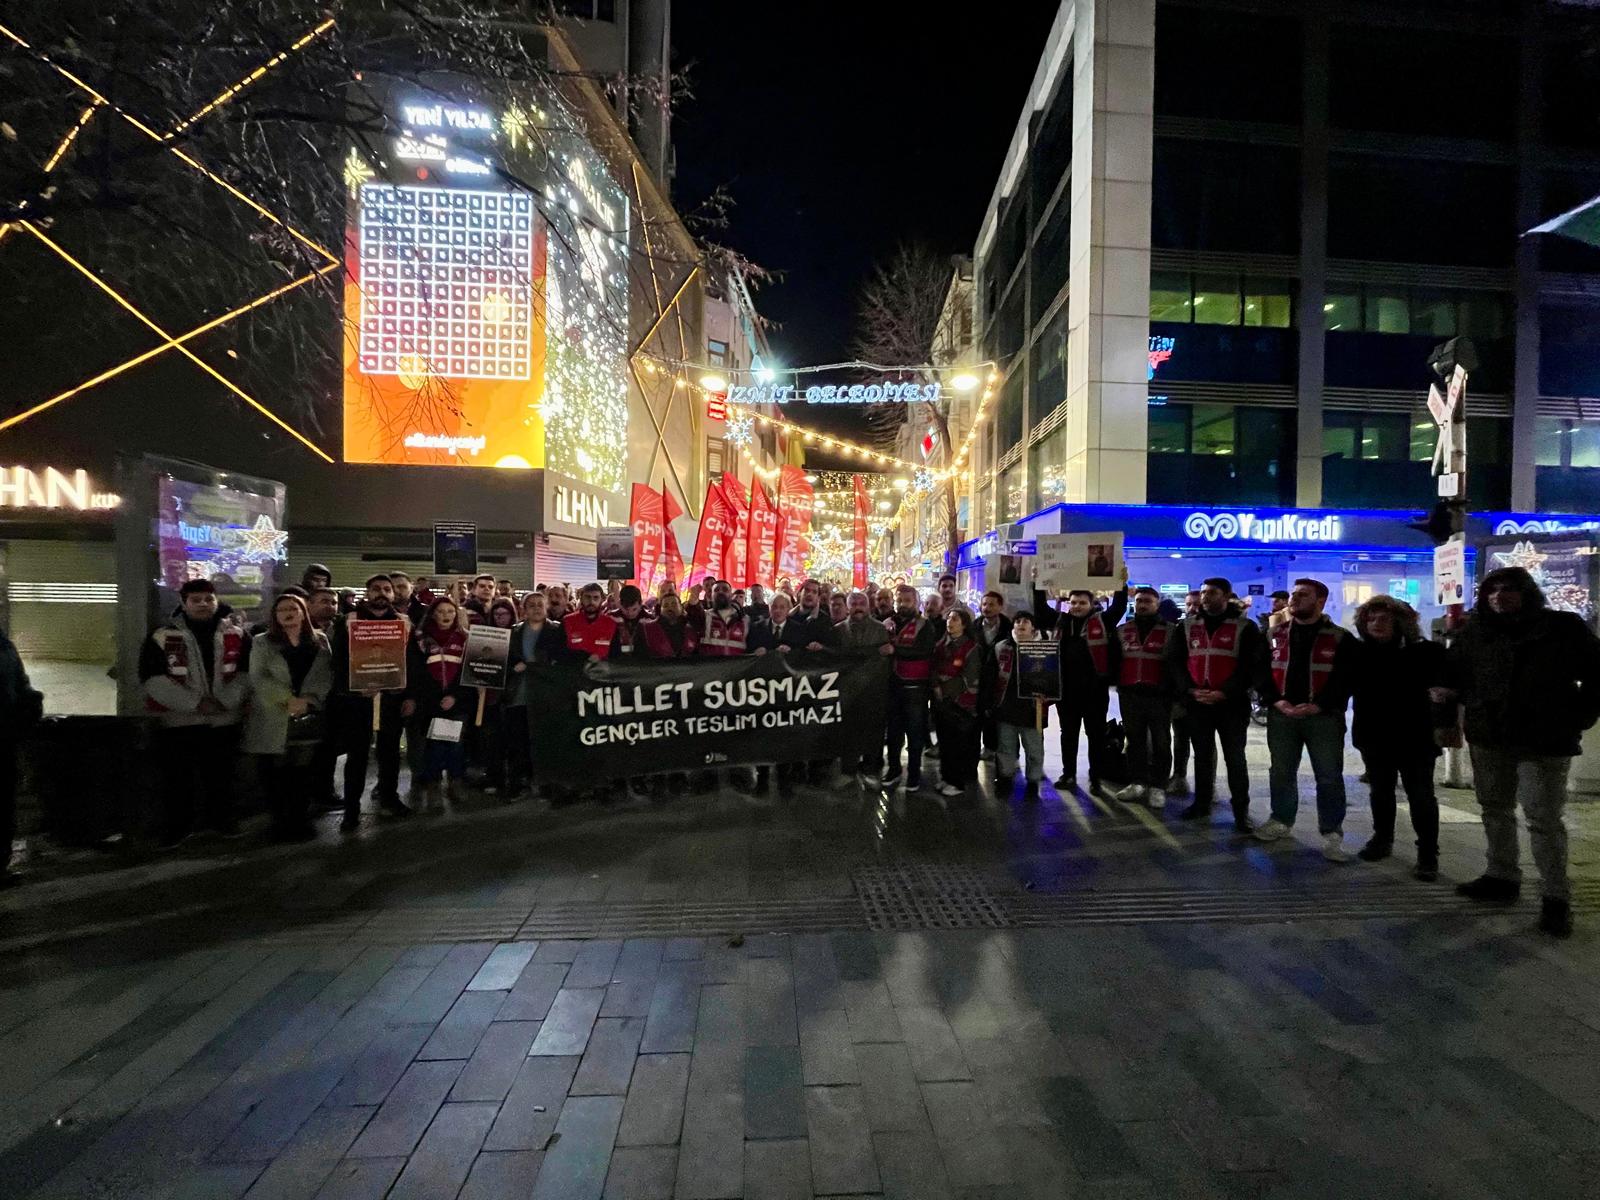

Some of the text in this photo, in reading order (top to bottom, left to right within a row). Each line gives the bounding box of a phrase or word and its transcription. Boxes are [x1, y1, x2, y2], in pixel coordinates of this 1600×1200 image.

[725, 383, 794, 404] İZMİT
[556, 485, 608, 528] İLHAN
[753, 509, 775, 524] CH
[1238, 513, 1340, 543] YapıKredi
[577, 671, 840, 717] MİLLET SUSMAZ
[579, 701, 843, 746] GENÇLER TESLİM OLMAZ!
